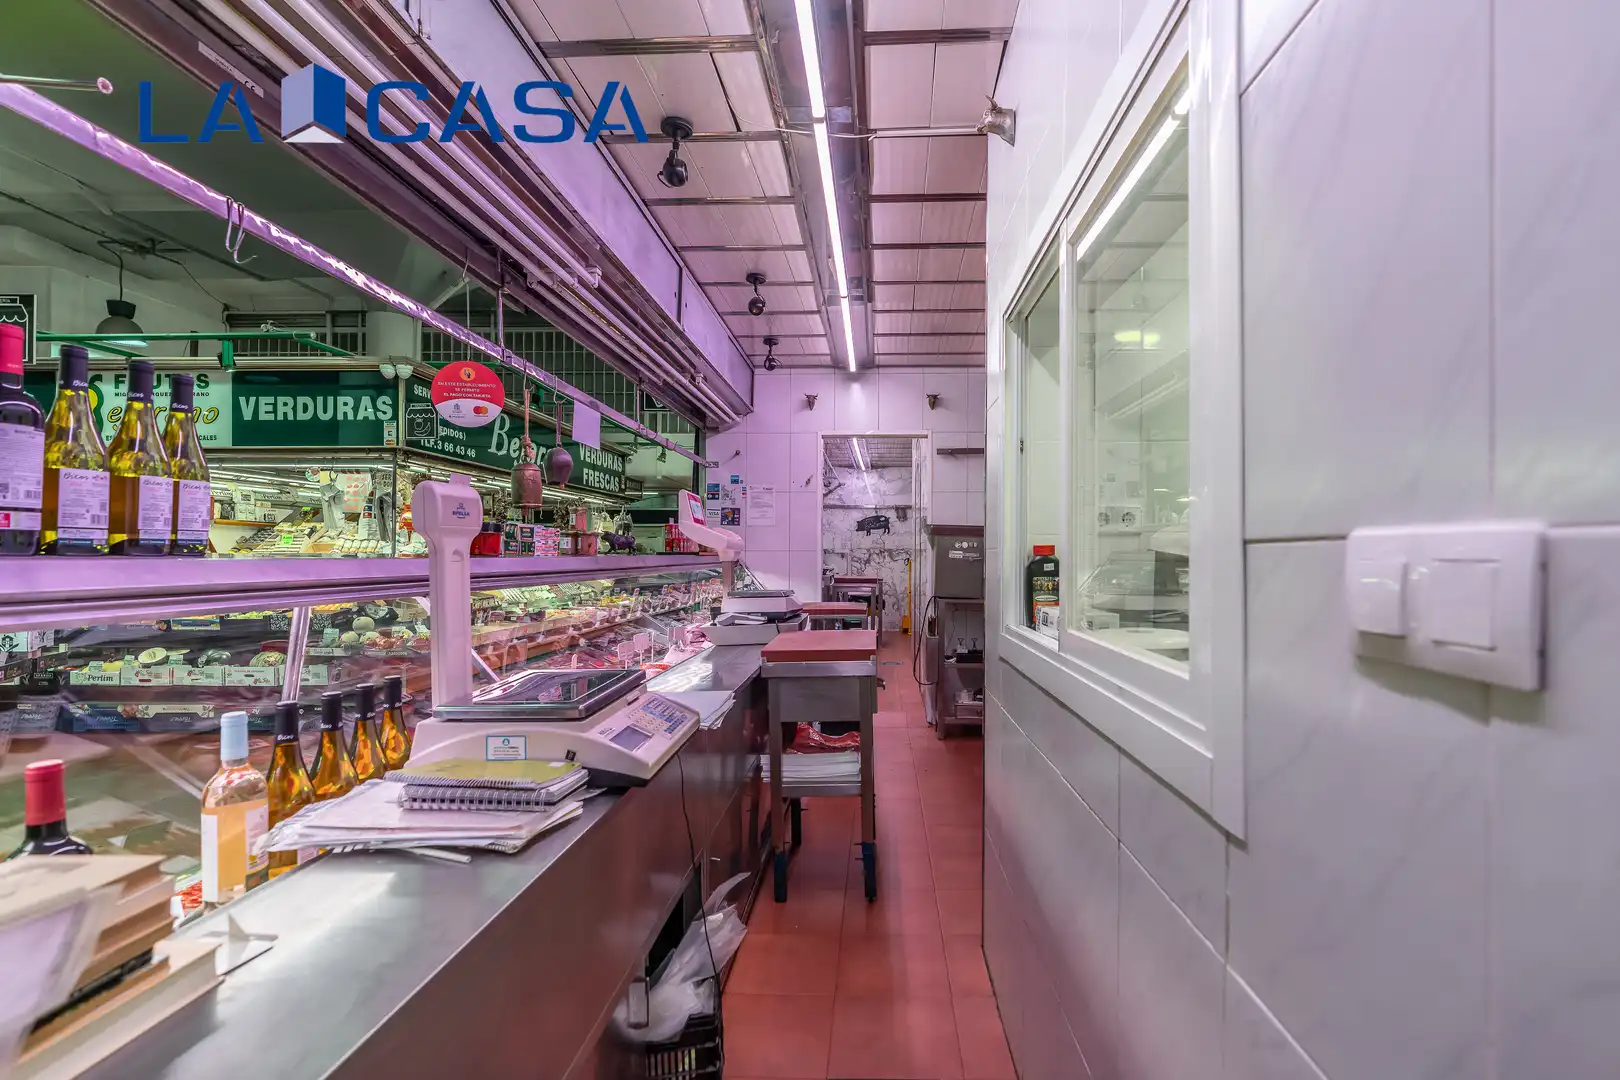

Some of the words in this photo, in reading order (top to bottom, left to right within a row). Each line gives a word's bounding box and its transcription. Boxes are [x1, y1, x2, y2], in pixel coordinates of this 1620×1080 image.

[238, 395, 393, 421] VERDURAS
[444, 442, 454, 452] 66
[456, 445, 465, 455] 43
[467, 447, 476, 458] 46
[579, 443, 623, 472] VERDURAS
[583, 468, 620, 492] FRESCAS
